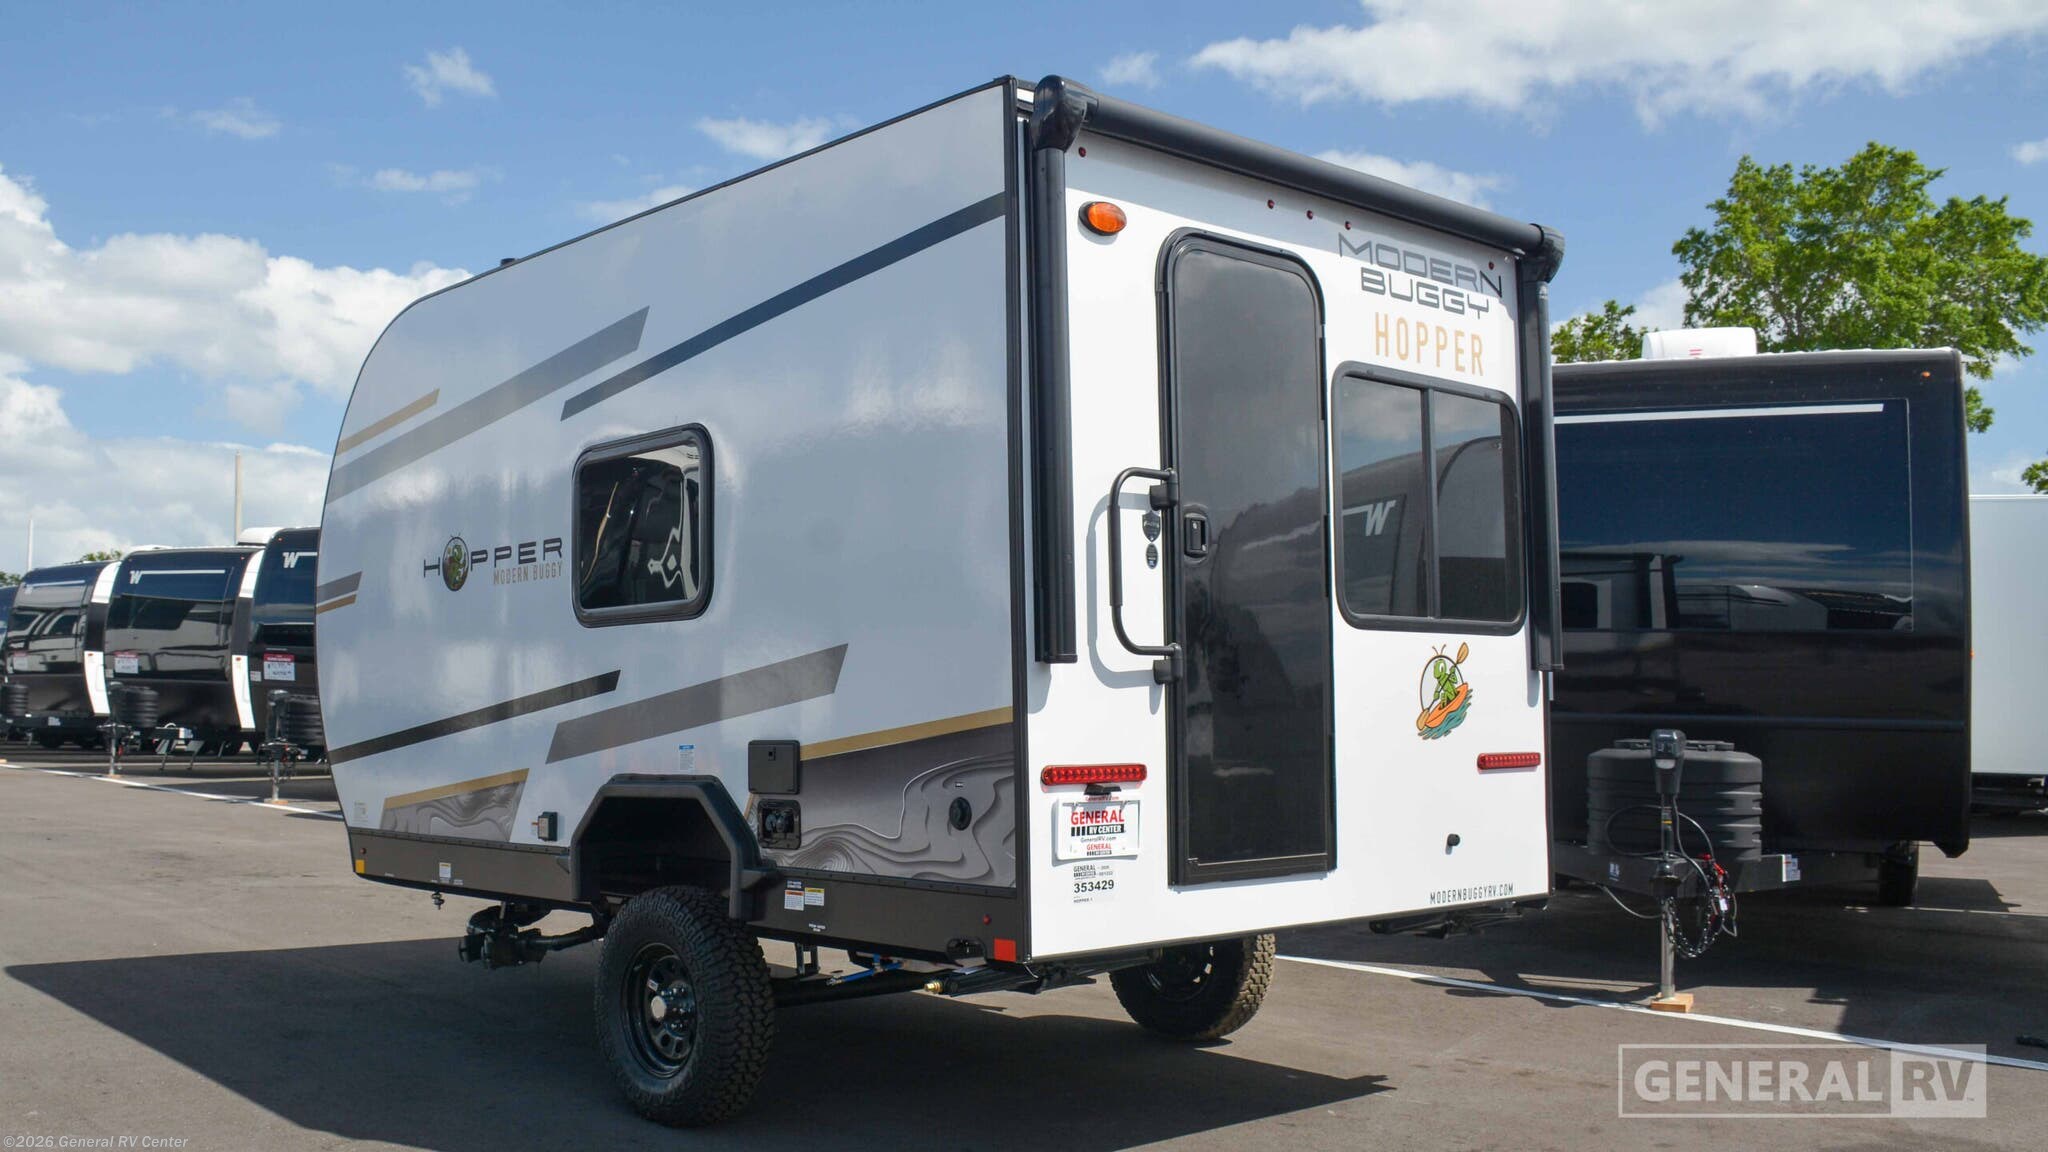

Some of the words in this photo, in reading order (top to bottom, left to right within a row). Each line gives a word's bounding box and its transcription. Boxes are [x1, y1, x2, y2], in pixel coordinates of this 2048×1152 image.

[1338, 232, 1503, 298] MODERN
[1361, 267, 1489, 319] BUGGY
[1374, 311, 1484, 376] HOPPER
[493, 566, 529, 585] MODERN
[533, 561, 563, 580] BUGGY
[1071, 809, 1125, 825] GENERAL
[1088, 826, 1098, 835] RV
[1098, 825, 1122, 834] CENTER
[1073, 879, 1115, 893] 353429
[1430, 883, 1514, 905] MODERNBUGGYRV.COM
